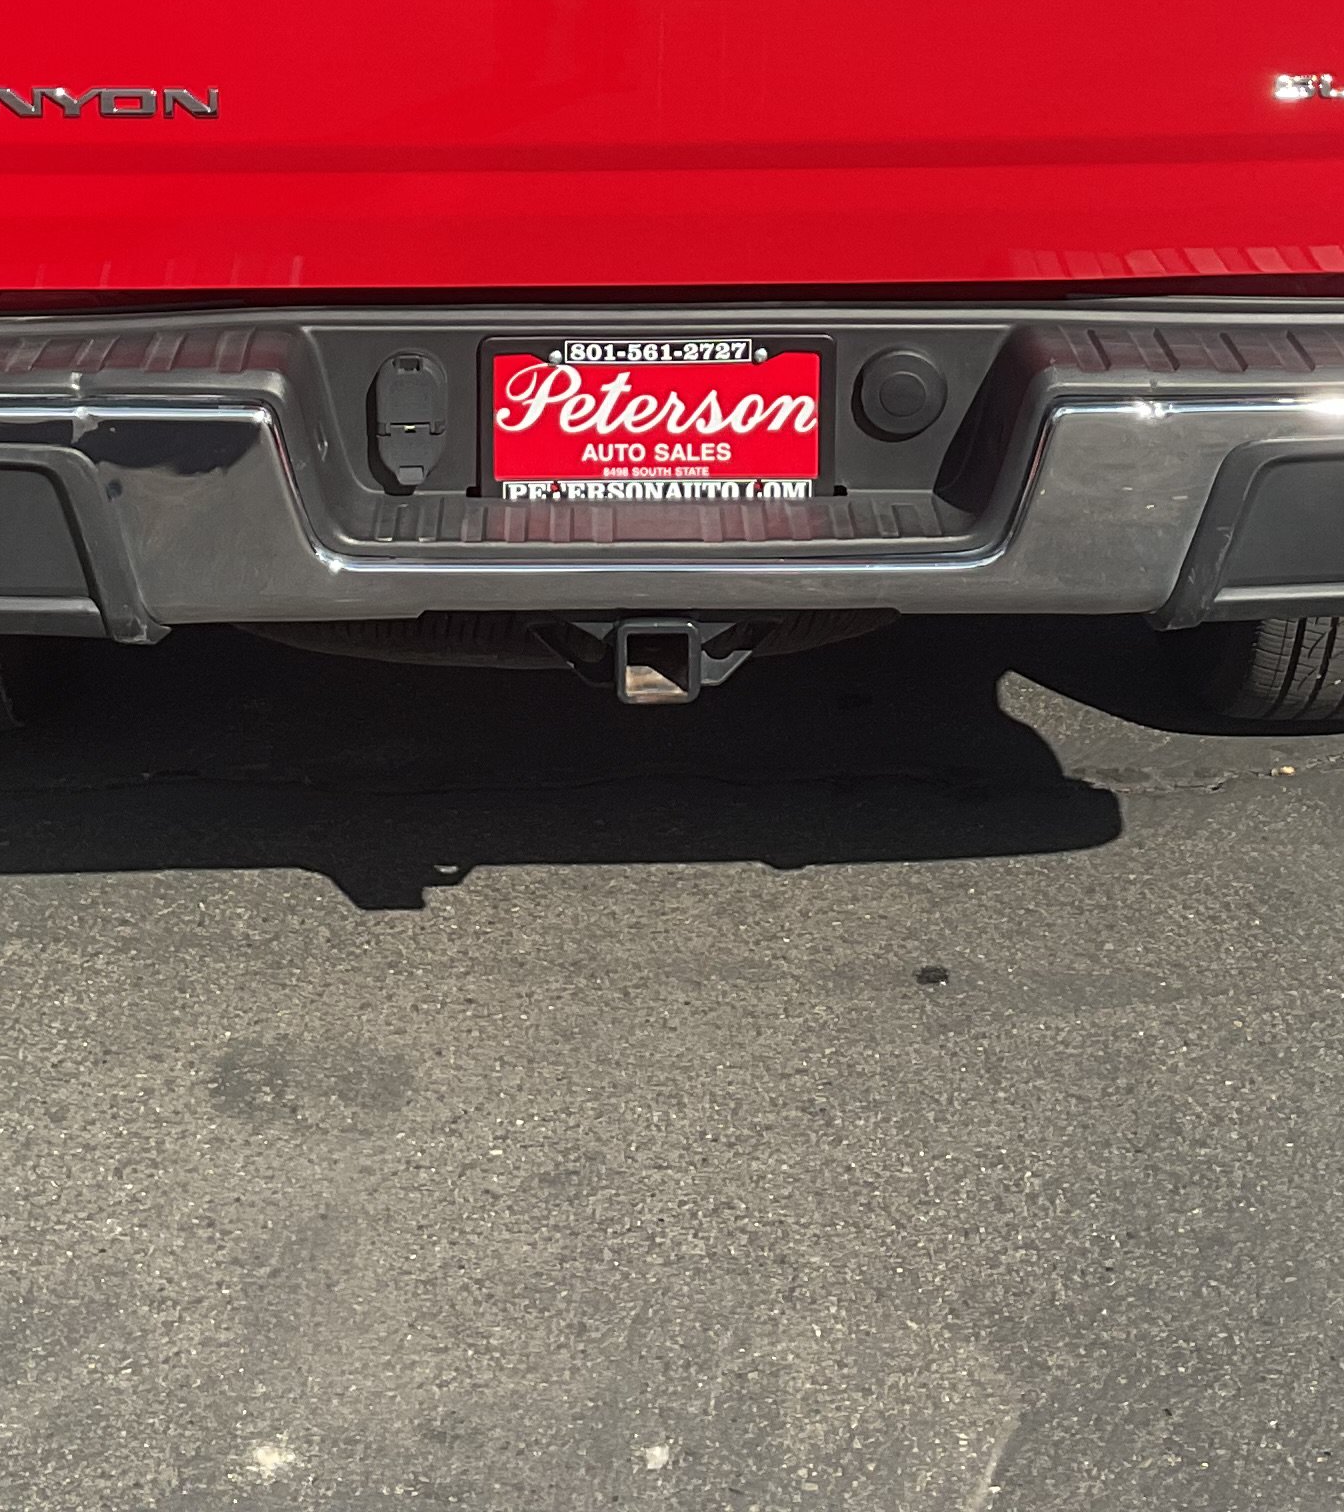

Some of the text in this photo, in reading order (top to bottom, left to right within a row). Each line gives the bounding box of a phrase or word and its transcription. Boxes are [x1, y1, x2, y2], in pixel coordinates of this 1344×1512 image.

[569, 342, 748, 361] 801-561-2727
[496, 363, 818, 435] Peterson
[581, 443, 732, 463] AUTO SALES
[632, 466, 672, 477] SOUTH
[675, 466, 710, 477] STATE
